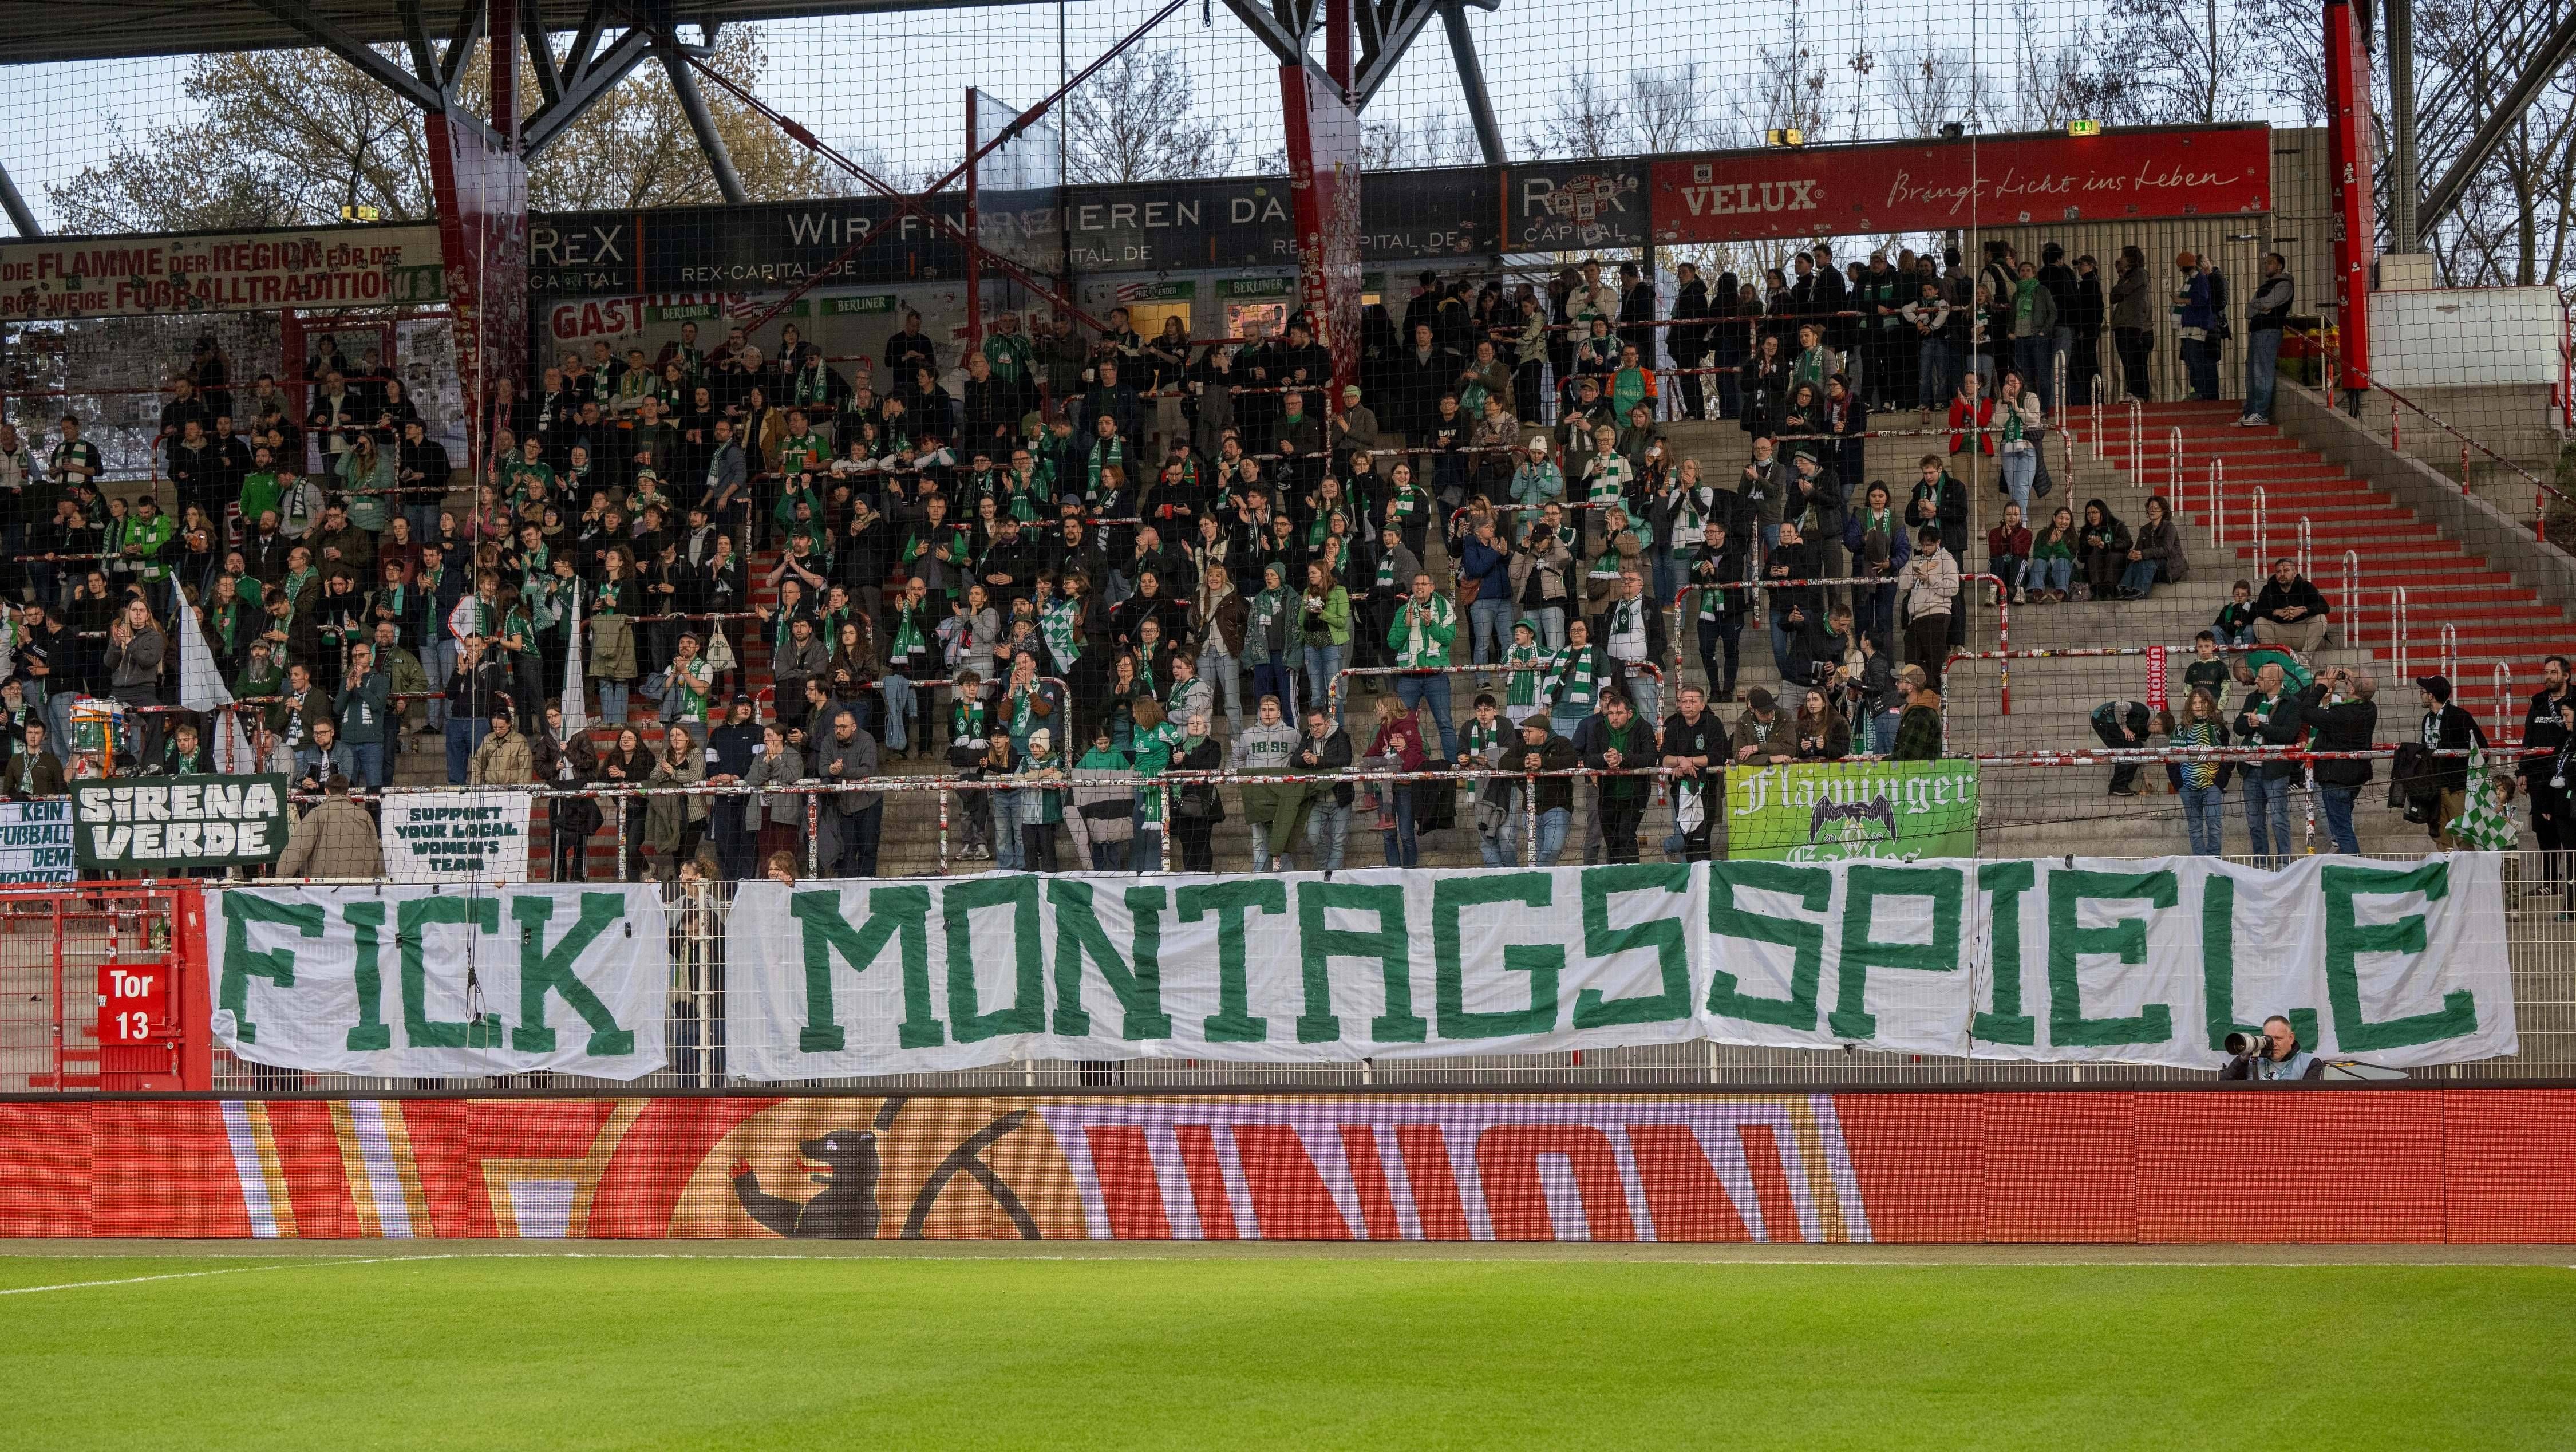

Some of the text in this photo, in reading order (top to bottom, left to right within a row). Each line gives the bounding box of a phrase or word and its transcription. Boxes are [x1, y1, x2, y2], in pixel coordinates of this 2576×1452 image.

[1887, 160, 2241, 215] Bringt Licht ins Leben
[787, 197, 1295, 246] WIR FINZIEREN DA
[1524, 223, 1626, 242] CAPIAL
[530, 224, 623, 265] REX
[2, 263, 33, 281] DIE
[38, 248, 163, 279] FLAMME
[169, 255, 208, 273] DER
[214, 241, 322, 271] REGION
[530, 271, 624, 289] CAITAL
[682, 261, 856, 282] REX-CAPITALDE
[1234, 278, 1284, 294] BERLINER
[662, 304, 710, 320] BERLINER
[837, 296, 886, 312] BERLINER
[2150, 648, 2162, 702] UNION
[1252, 741, 1288, 753] 1899
[1735, 767, 1973, 815] Fläminger
[22, 802, 64, 821] KEIN
[410, 807, 502, 822] SUPPORT
[92, 821, 271, 860] VERDE
[395, 823, 518, 839] YOUR LOCAL
[1823, 832, 1884, 842] 20 08
[33, 847, 70, 867] DEM
[412, 841, 499, 855] WOMEN'S
[429, 858, 484, 871] TEAM
[219, 859, 2478, 1055] FICK MONTAGSSPIELE
[110, 970, 153, 999] Tor
[116, 1012, 148, 1040] 13
